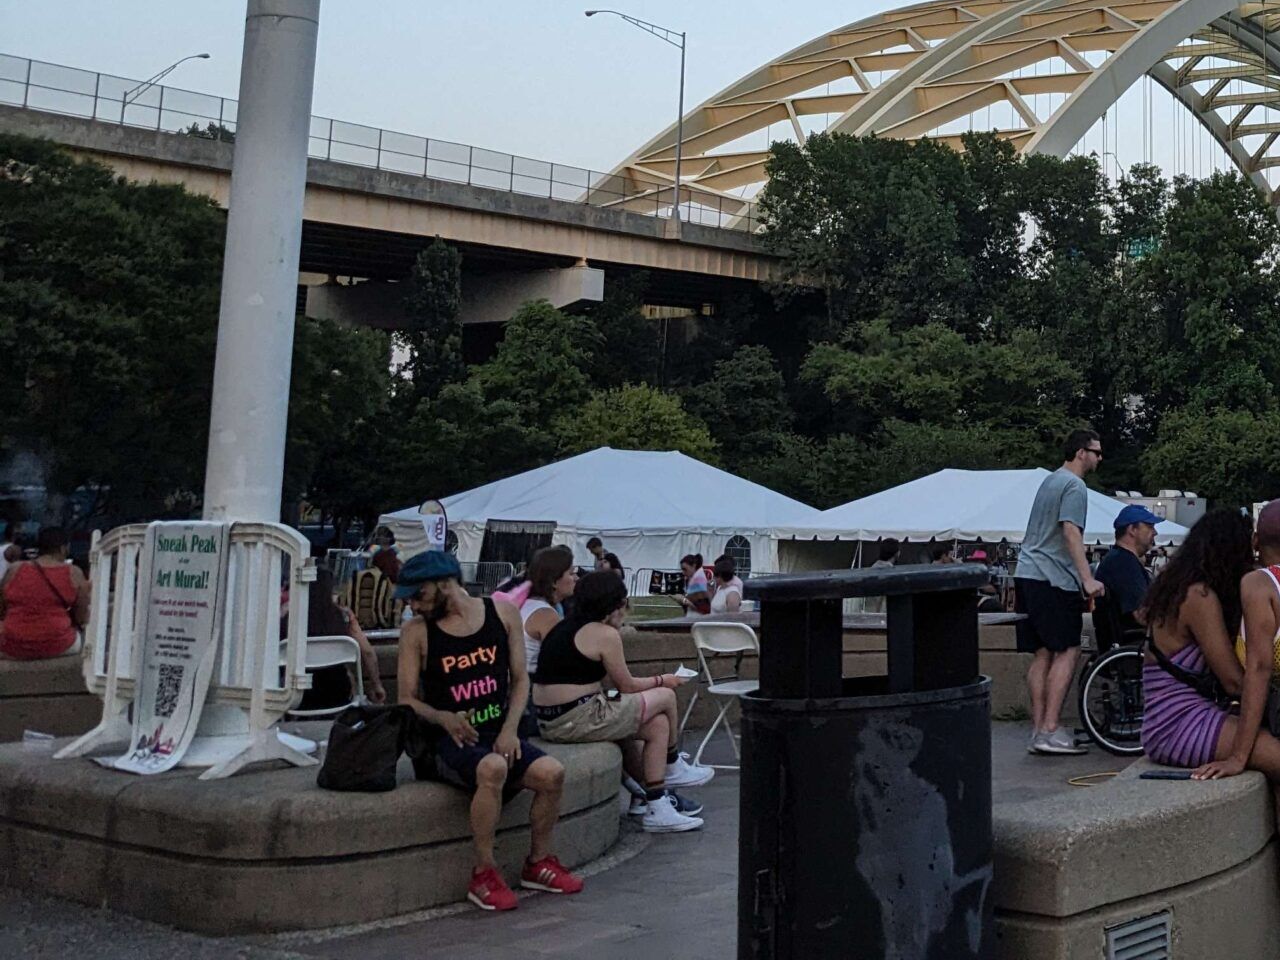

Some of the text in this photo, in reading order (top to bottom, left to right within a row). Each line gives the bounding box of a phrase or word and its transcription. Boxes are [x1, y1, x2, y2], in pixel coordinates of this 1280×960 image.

[157, 535, 216, 554] Sneak Peak
[157, 569, 210, 589] Art Mural!
[441, 645, 497, 673] Party
[450, 675, 498, 702] With
